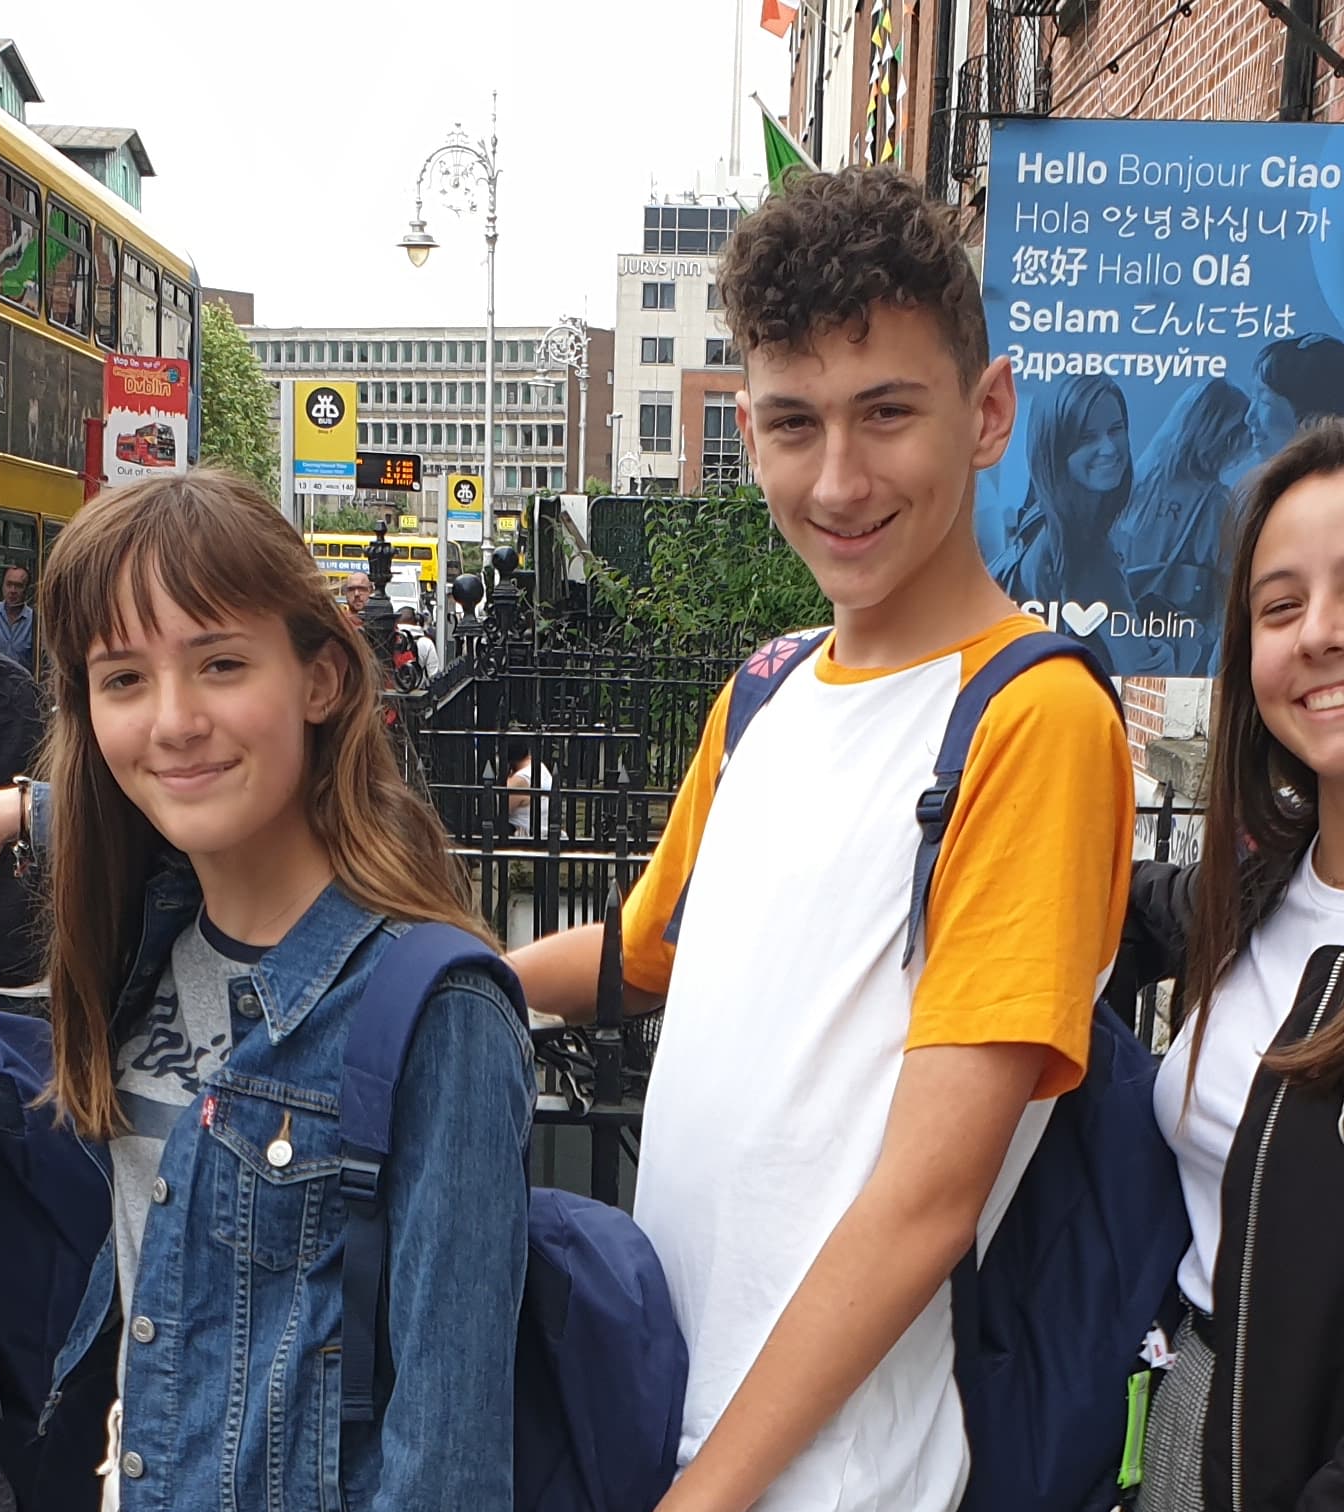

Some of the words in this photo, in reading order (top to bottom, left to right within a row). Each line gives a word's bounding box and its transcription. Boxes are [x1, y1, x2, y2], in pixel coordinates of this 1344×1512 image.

[1017, 151, 1108, 185] Hello
[1118, 153, 1252, 193] Bonjour
[1260, 155, 1341, 189] Ciao
[1015, 201, 1089, 234] Hola
[1102, 205, 1331, 243] 안녕하십니까
[618, 257, 668, 276] JURYS
[1011, 245, 1089, 287] 您好
[1098, 252, 1182, 286] Hallo
[1192, 253, 1252, 287] Olá
[1008, 300, 1120, 334] Selam
[1130, 301, 1297, 338] こんにちは
[1008, 345, 1227, 384] Здравствуйте
[117, 465, 134, 475] Out
[1012, 600, 1059, 633] SI
[1109, 610, 1196, 638] Dublin
